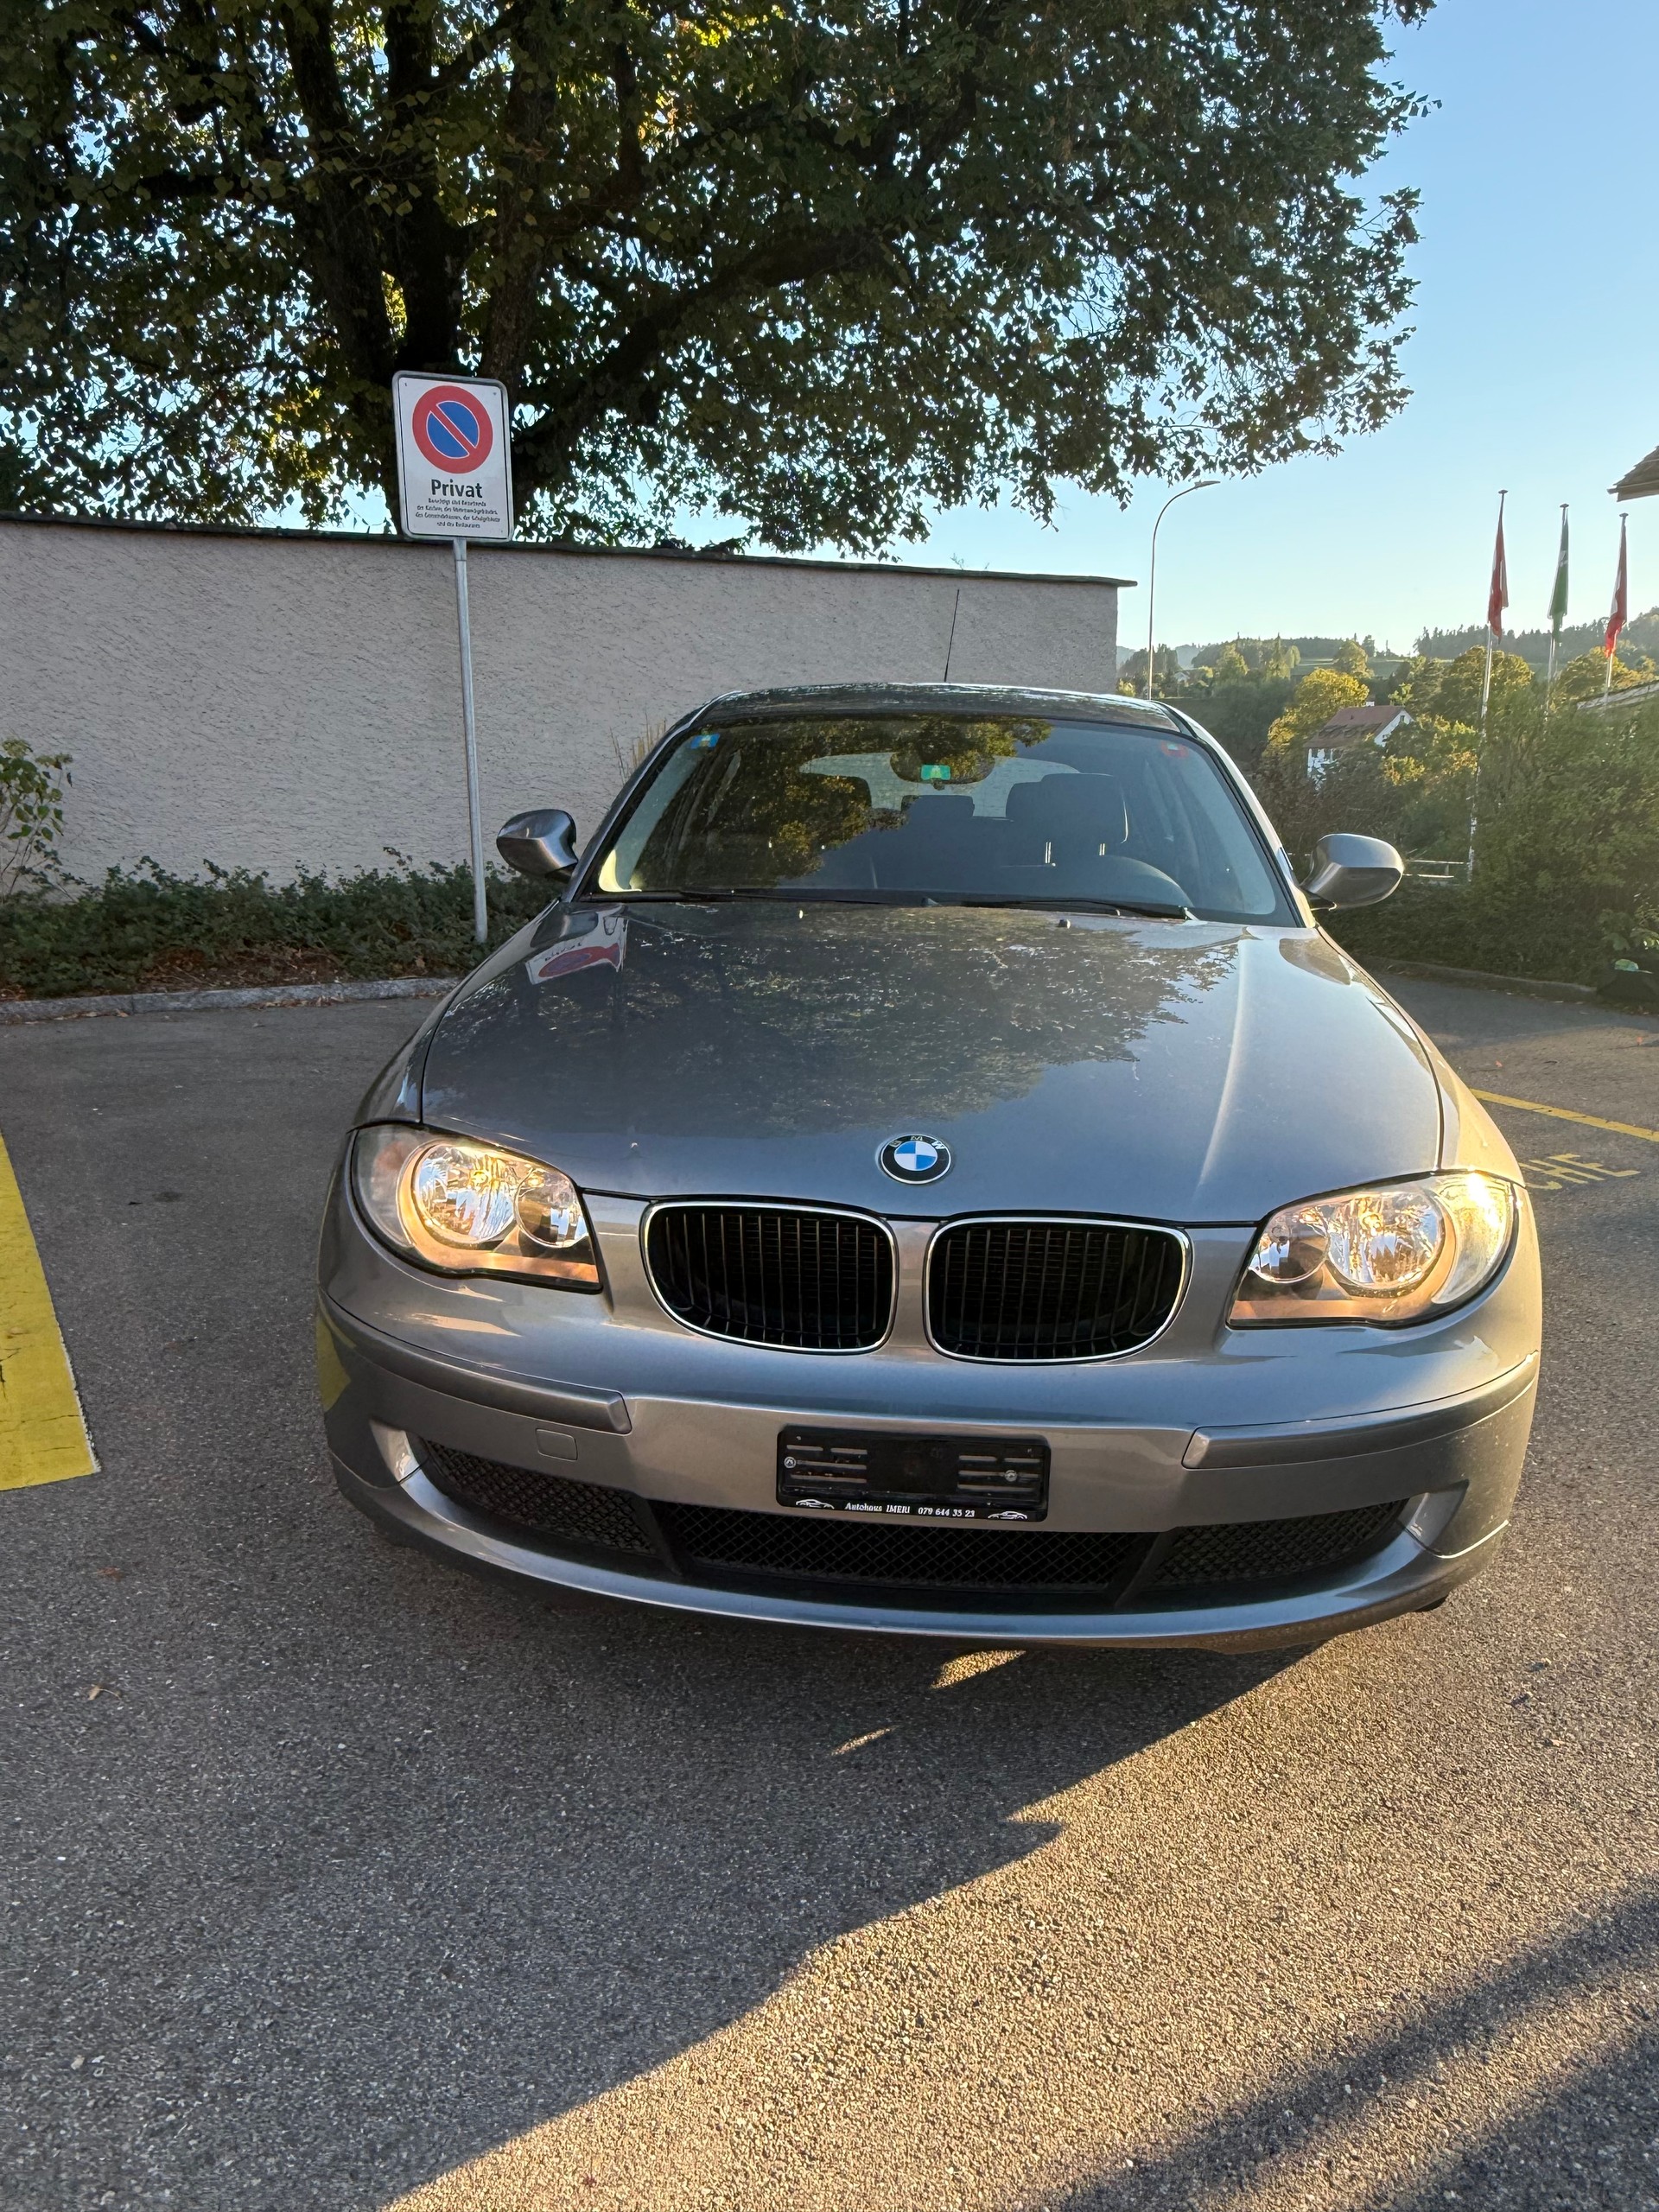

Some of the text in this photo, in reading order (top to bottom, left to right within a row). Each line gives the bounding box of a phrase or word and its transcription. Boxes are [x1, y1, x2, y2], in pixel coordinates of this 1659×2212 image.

[431, 479, 482, 498] Privat
[889, 1135, 945, 1149] BMW
[844, 1502, 882, 1512] Autohaus
